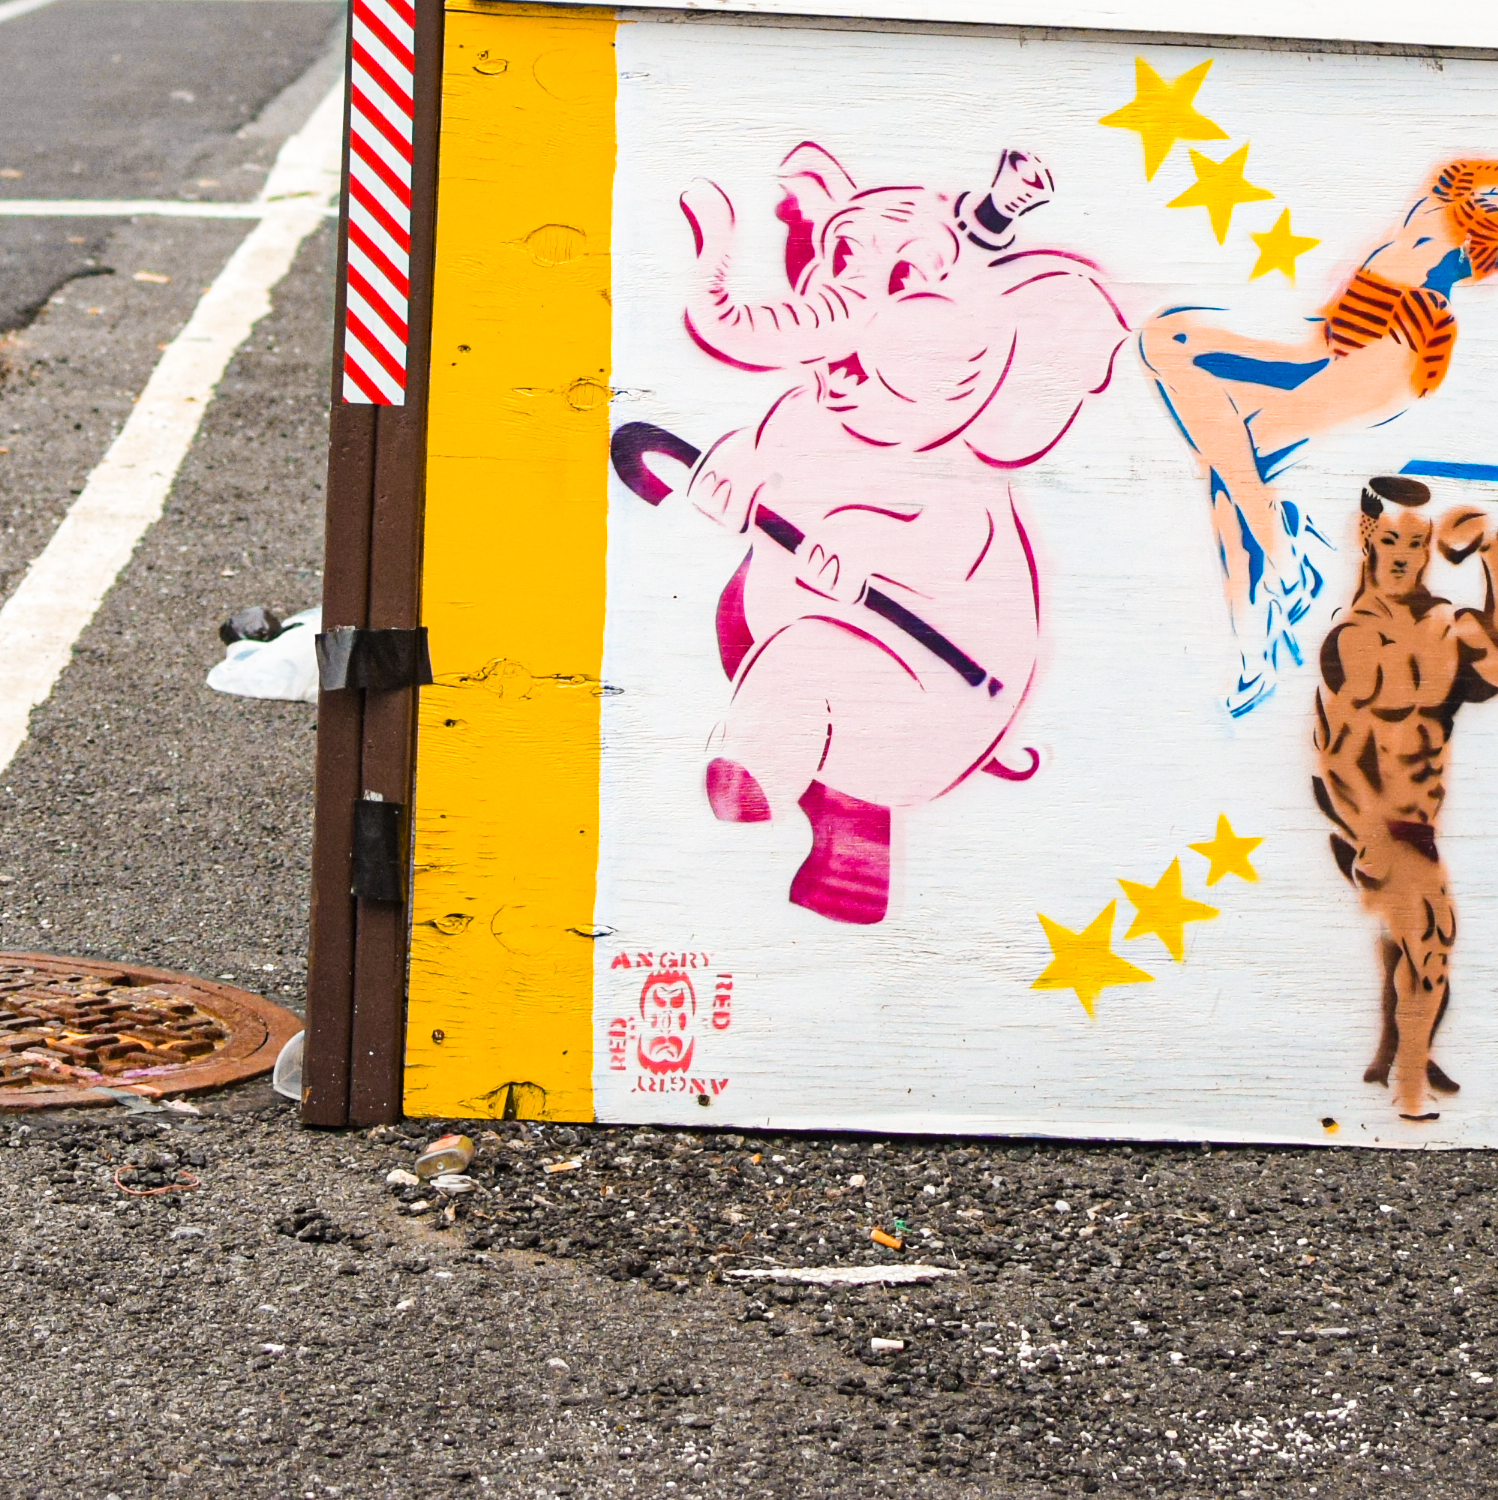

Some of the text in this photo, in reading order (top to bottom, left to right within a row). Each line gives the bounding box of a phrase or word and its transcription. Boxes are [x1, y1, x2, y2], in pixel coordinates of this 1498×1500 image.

[610, 951, 714, 969] ANGRY
[712, 973, 733, 1030] RED
[608, 1017, 627, 1070] RED
[631, 1076, 729, 1095] ANGRY
